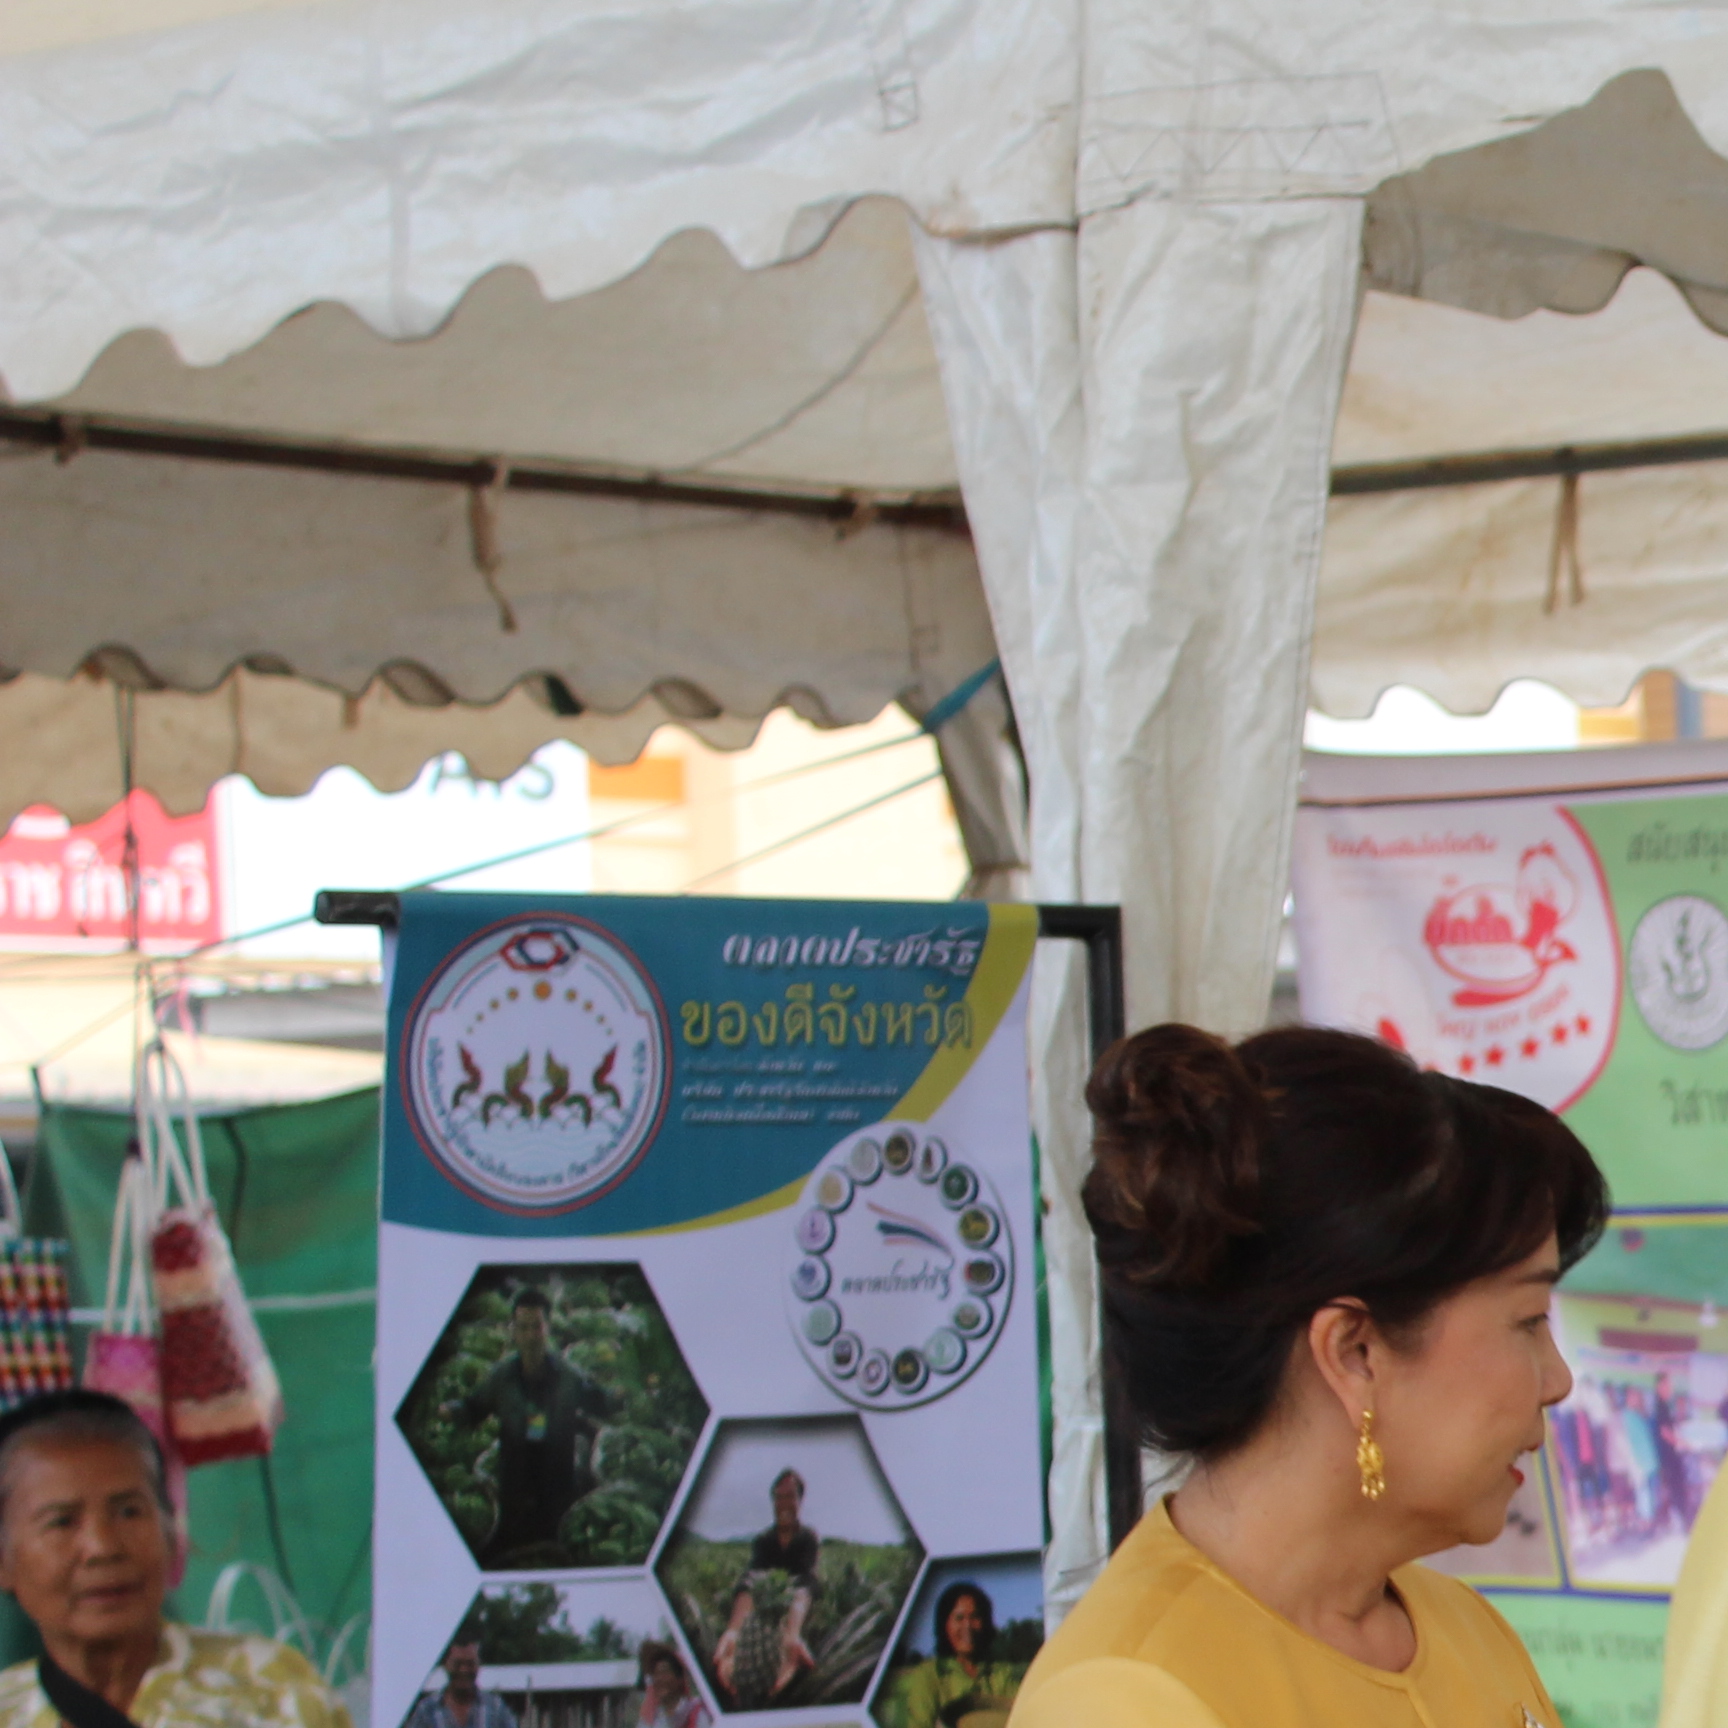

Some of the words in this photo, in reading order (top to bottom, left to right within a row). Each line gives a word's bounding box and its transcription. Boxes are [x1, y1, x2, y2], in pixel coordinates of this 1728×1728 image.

[721, 926, 981, 976] ตลาดประชารัฐ
[677, 981, 976, 1050] ของดีจังหวัด
